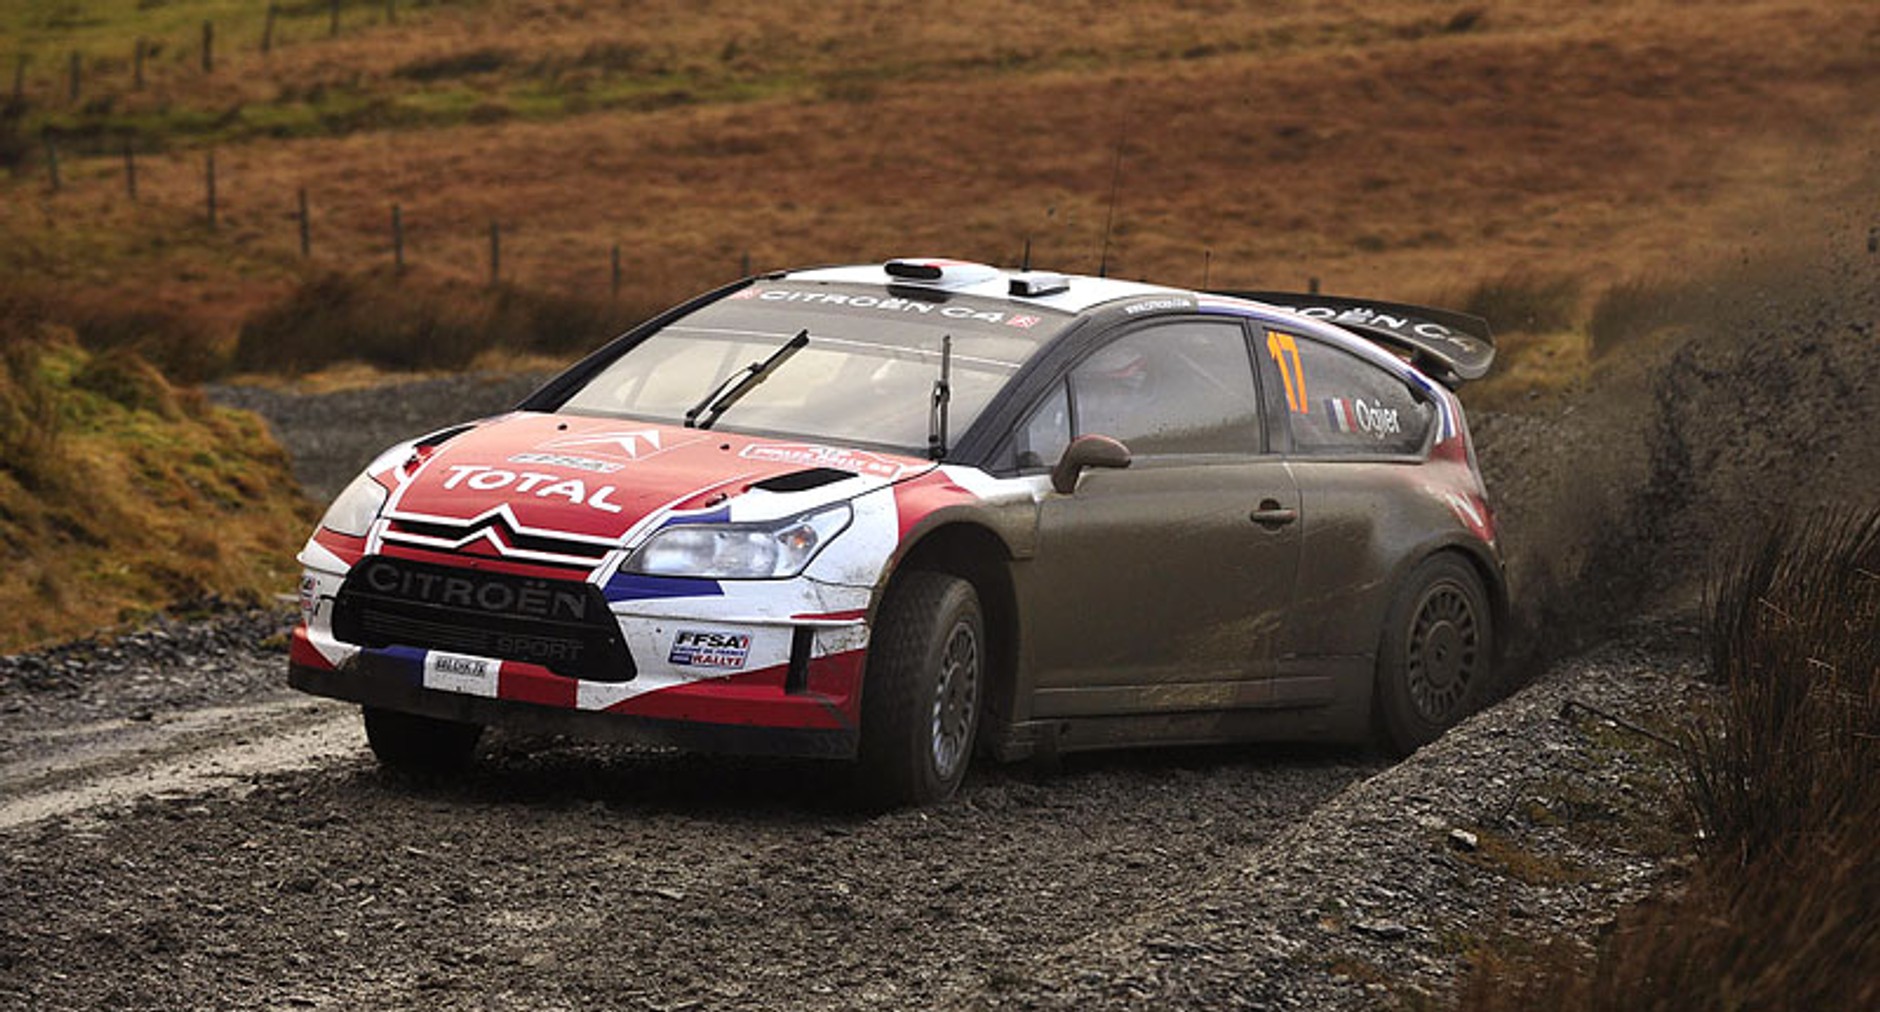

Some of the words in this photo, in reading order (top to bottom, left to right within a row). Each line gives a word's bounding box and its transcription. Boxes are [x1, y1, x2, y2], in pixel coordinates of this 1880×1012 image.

[940, 306, 1005, 323] C4
[1266, 331, 1309, 414] 17
[1355, 398, 1401, 439] Ogier
[443, 465, 623, 514] TOTAL
[367, 562, 588, 620] CITROËN
[677, 631, 739, 648] FFSA
[692, 655, 743, 667] RALLYE
